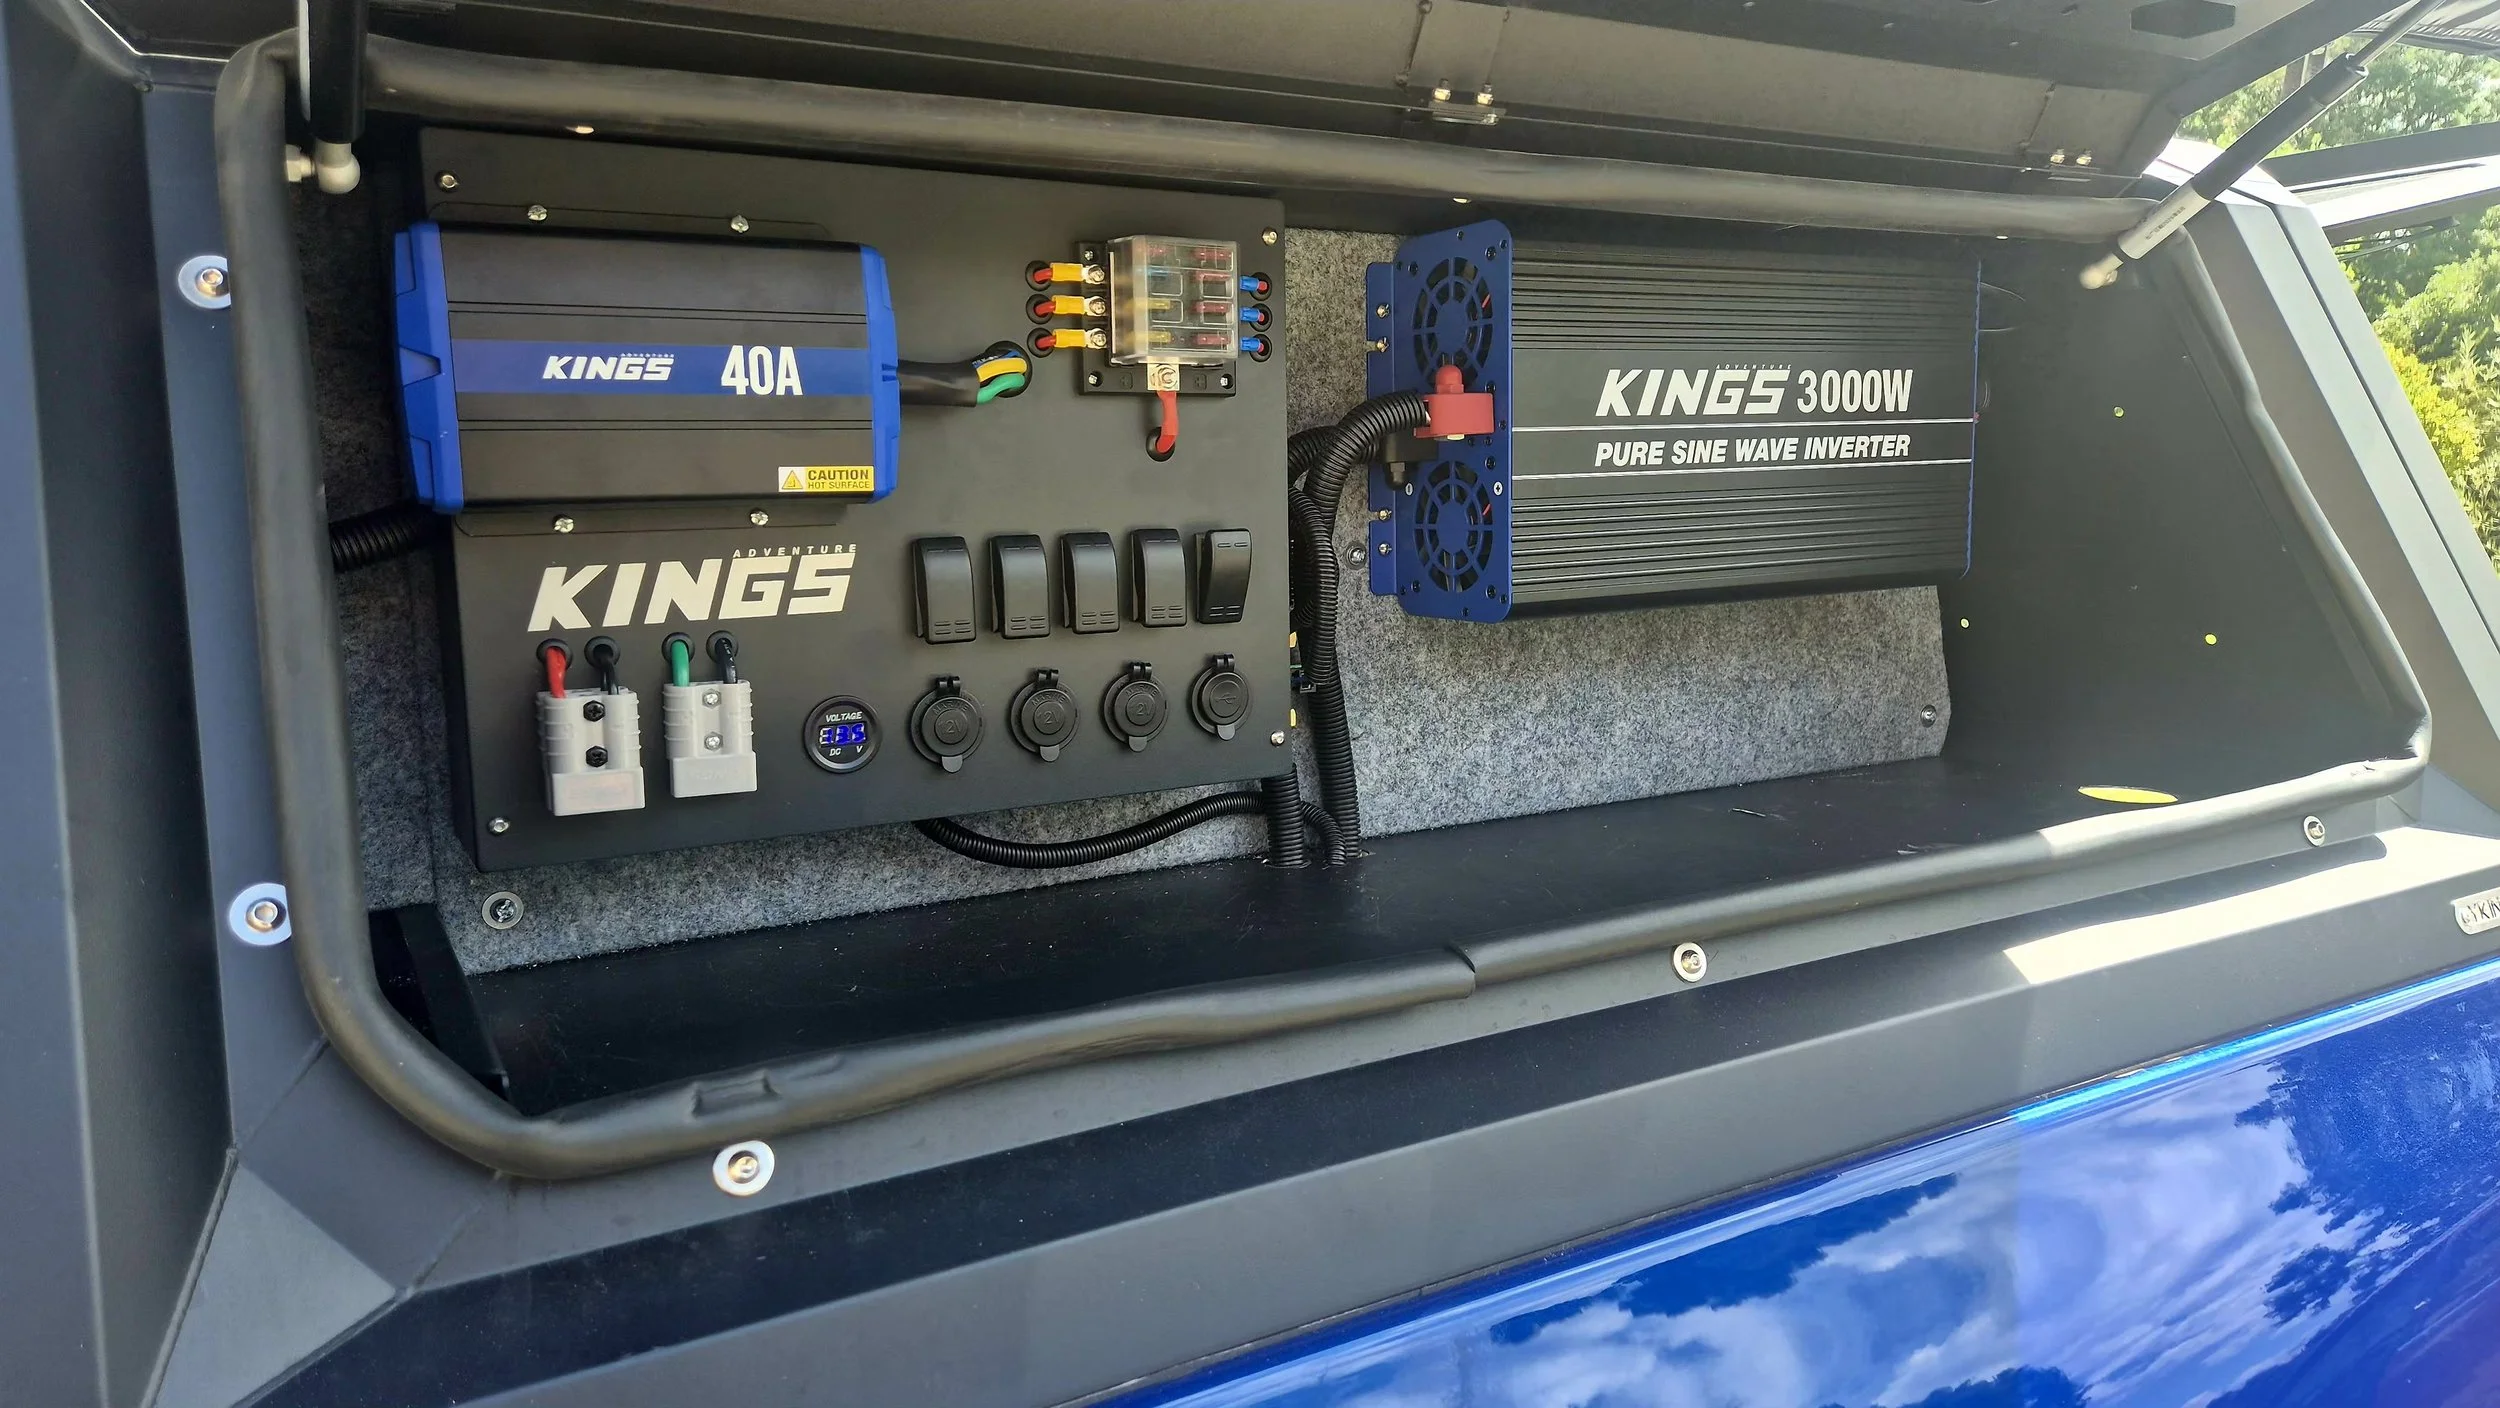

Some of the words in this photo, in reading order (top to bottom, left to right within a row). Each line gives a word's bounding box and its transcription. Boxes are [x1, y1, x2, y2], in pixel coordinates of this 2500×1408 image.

[541, 355, 675, 381] KINGS
[720, 344, 804, 397] 40A
[1595, 368, 1792, 417] KINGS
[1797, 368, 1913, 414] 3000W
[1595, 441, 1665, 467] PURE
[1671, 439, 1729, 464] SINE
[1735, 437, 1800, 462] WAVE
[1803, 434, 1912, 461] INVERTER
[807, 469, 869, 481] CAUTION
[808, 481, 826, 489] HOT
[828, 480, 870, 489] SURFACE
[733, 543, 857, 559] ADVENTURE
[527, 552, 857, 632] KINGS
[825, 711, 863, 723] VOLTAGE
[829, 748, 842, 757] DC
[856, 745, 863, 753] V
